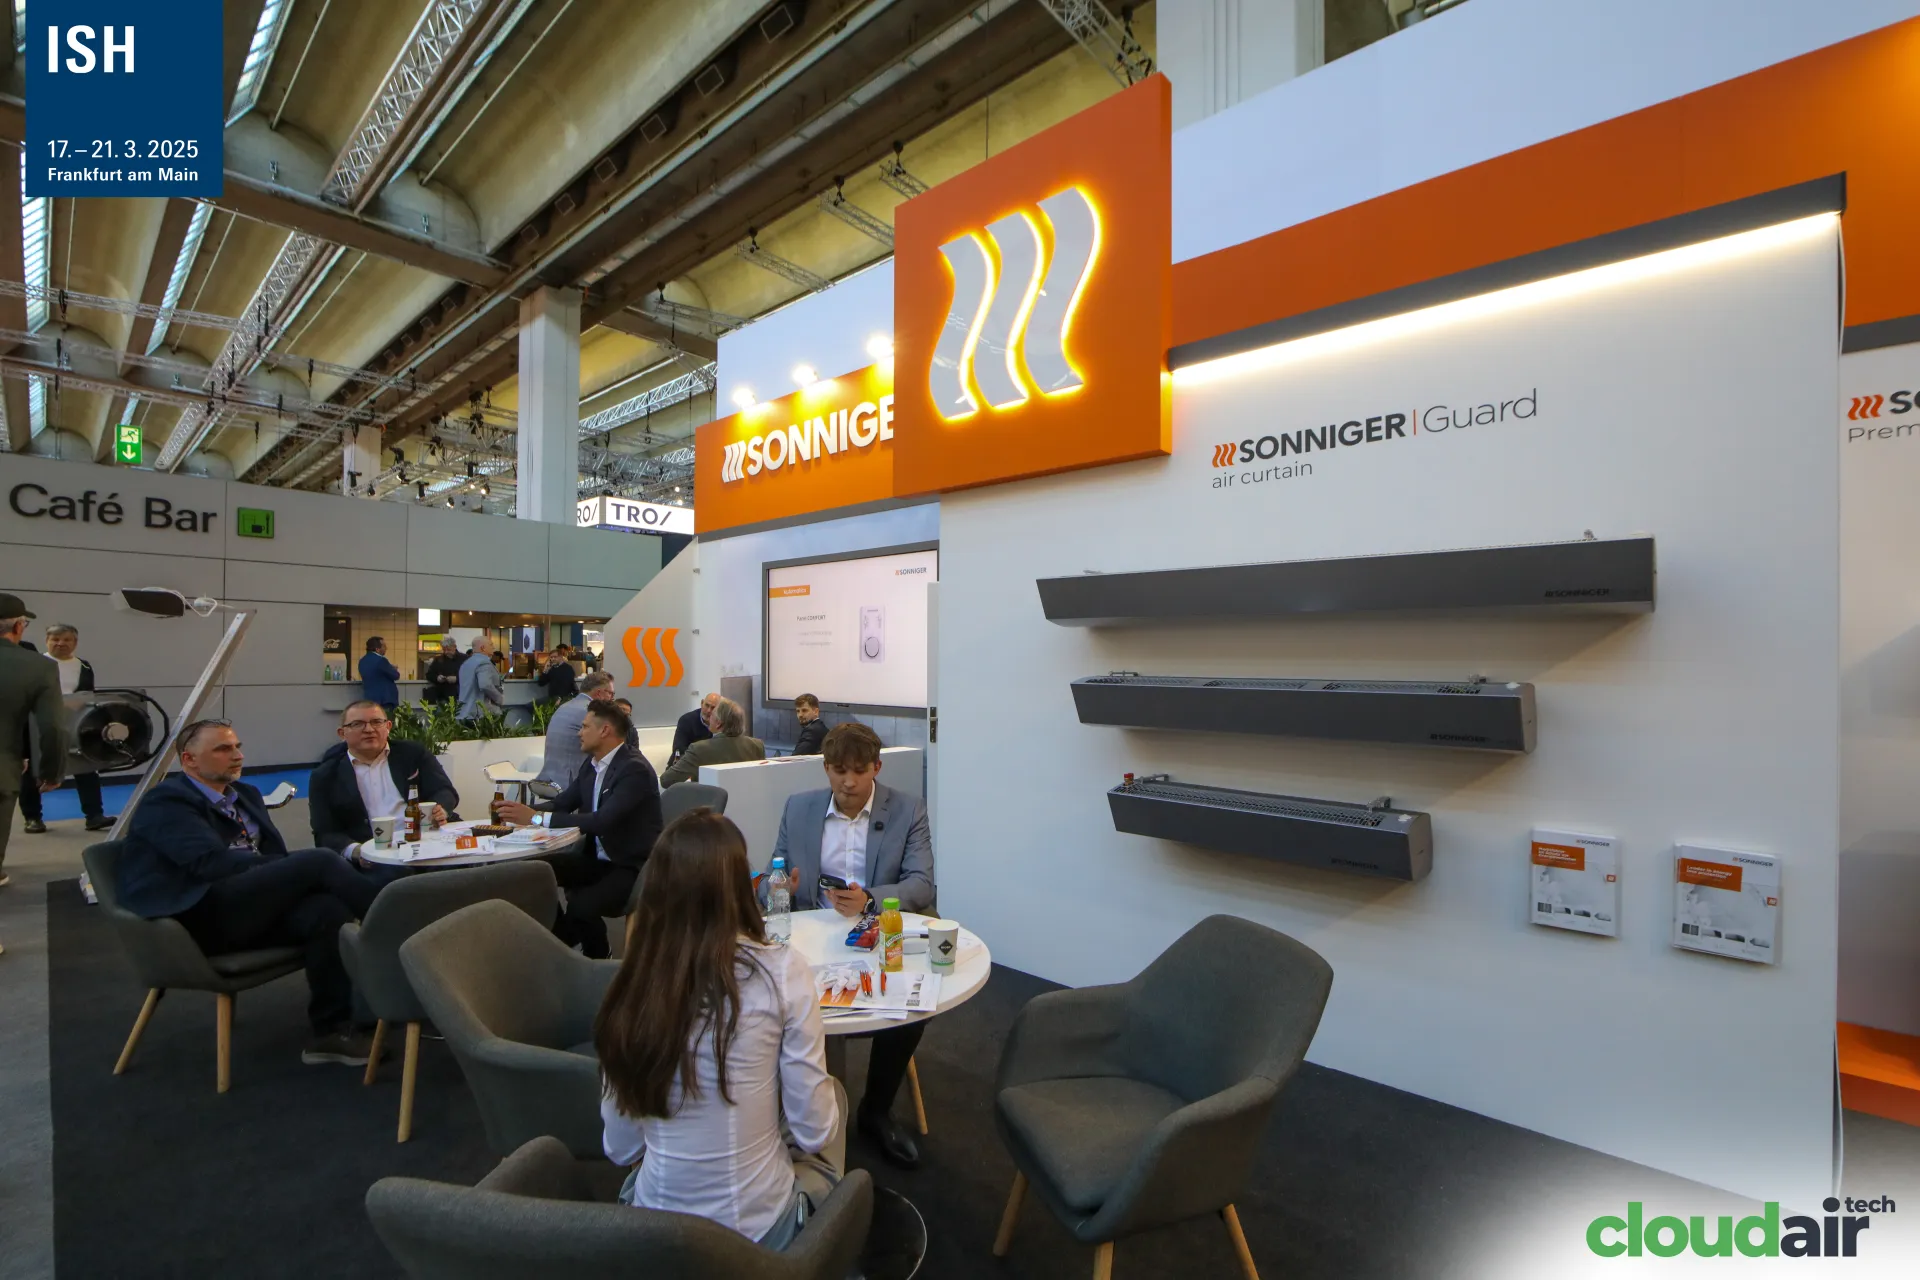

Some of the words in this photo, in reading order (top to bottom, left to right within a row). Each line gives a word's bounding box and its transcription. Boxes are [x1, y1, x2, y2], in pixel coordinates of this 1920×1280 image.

[1889, 390, 1920, 414] S
[1238, 413, 1407, 463] SONNIGER
[1422, 388, 1537, 433] Guard
[1212, 471, 1235, 488] air
[1240, 461, 1313, 484] curtain
[9, 483, 124, 525] Café
[144, 496, 218, 533] Bar
[899, 567, 927, 575] SONNIGER
[1738, 857, 1774, 867] SONNIGER
